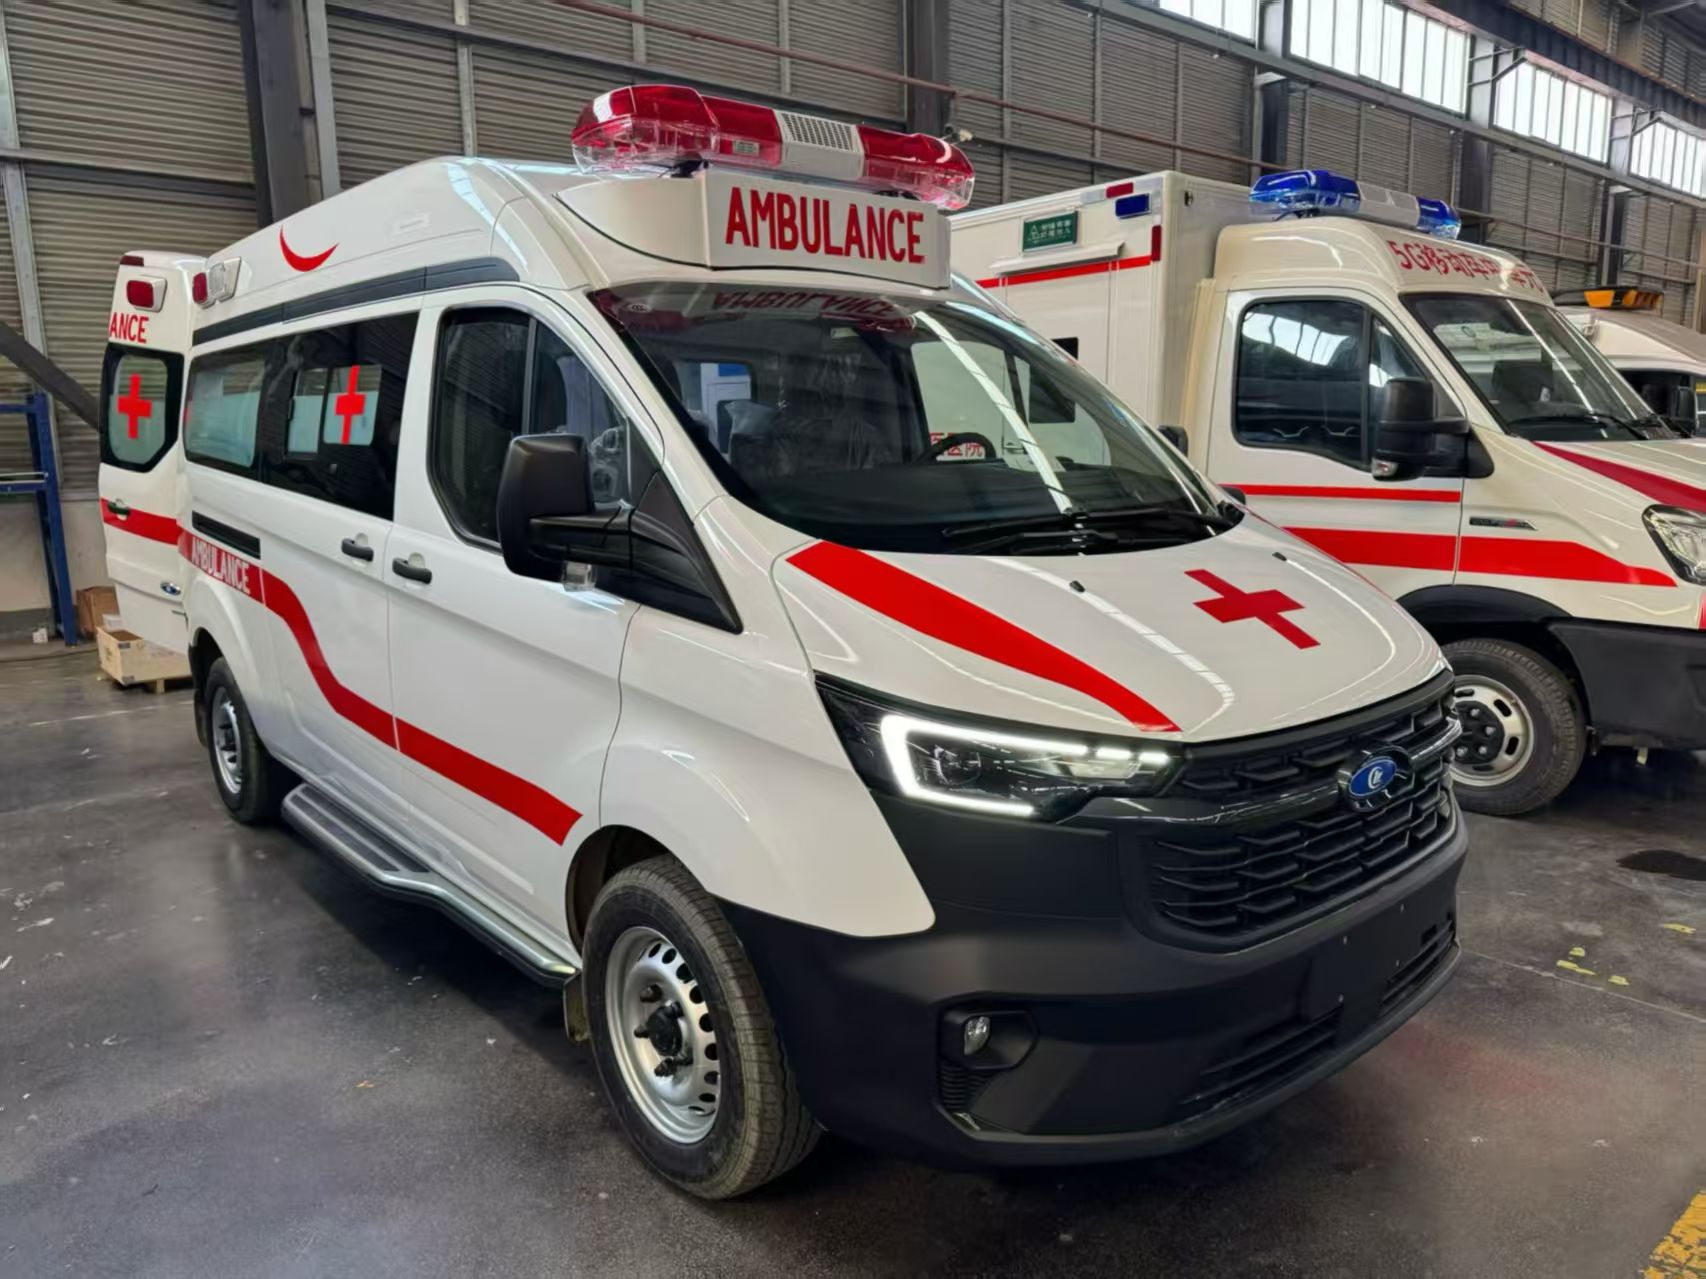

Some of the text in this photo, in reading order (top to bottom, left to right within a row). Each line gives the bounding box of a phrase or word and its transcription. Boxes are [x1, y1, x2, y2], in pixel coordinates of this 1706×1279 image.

[725, 186, 925, 264] AMBULANCE
[107, 311, 149, 345] ANCE
[190, 535, 252, 596] AMBULANCE
